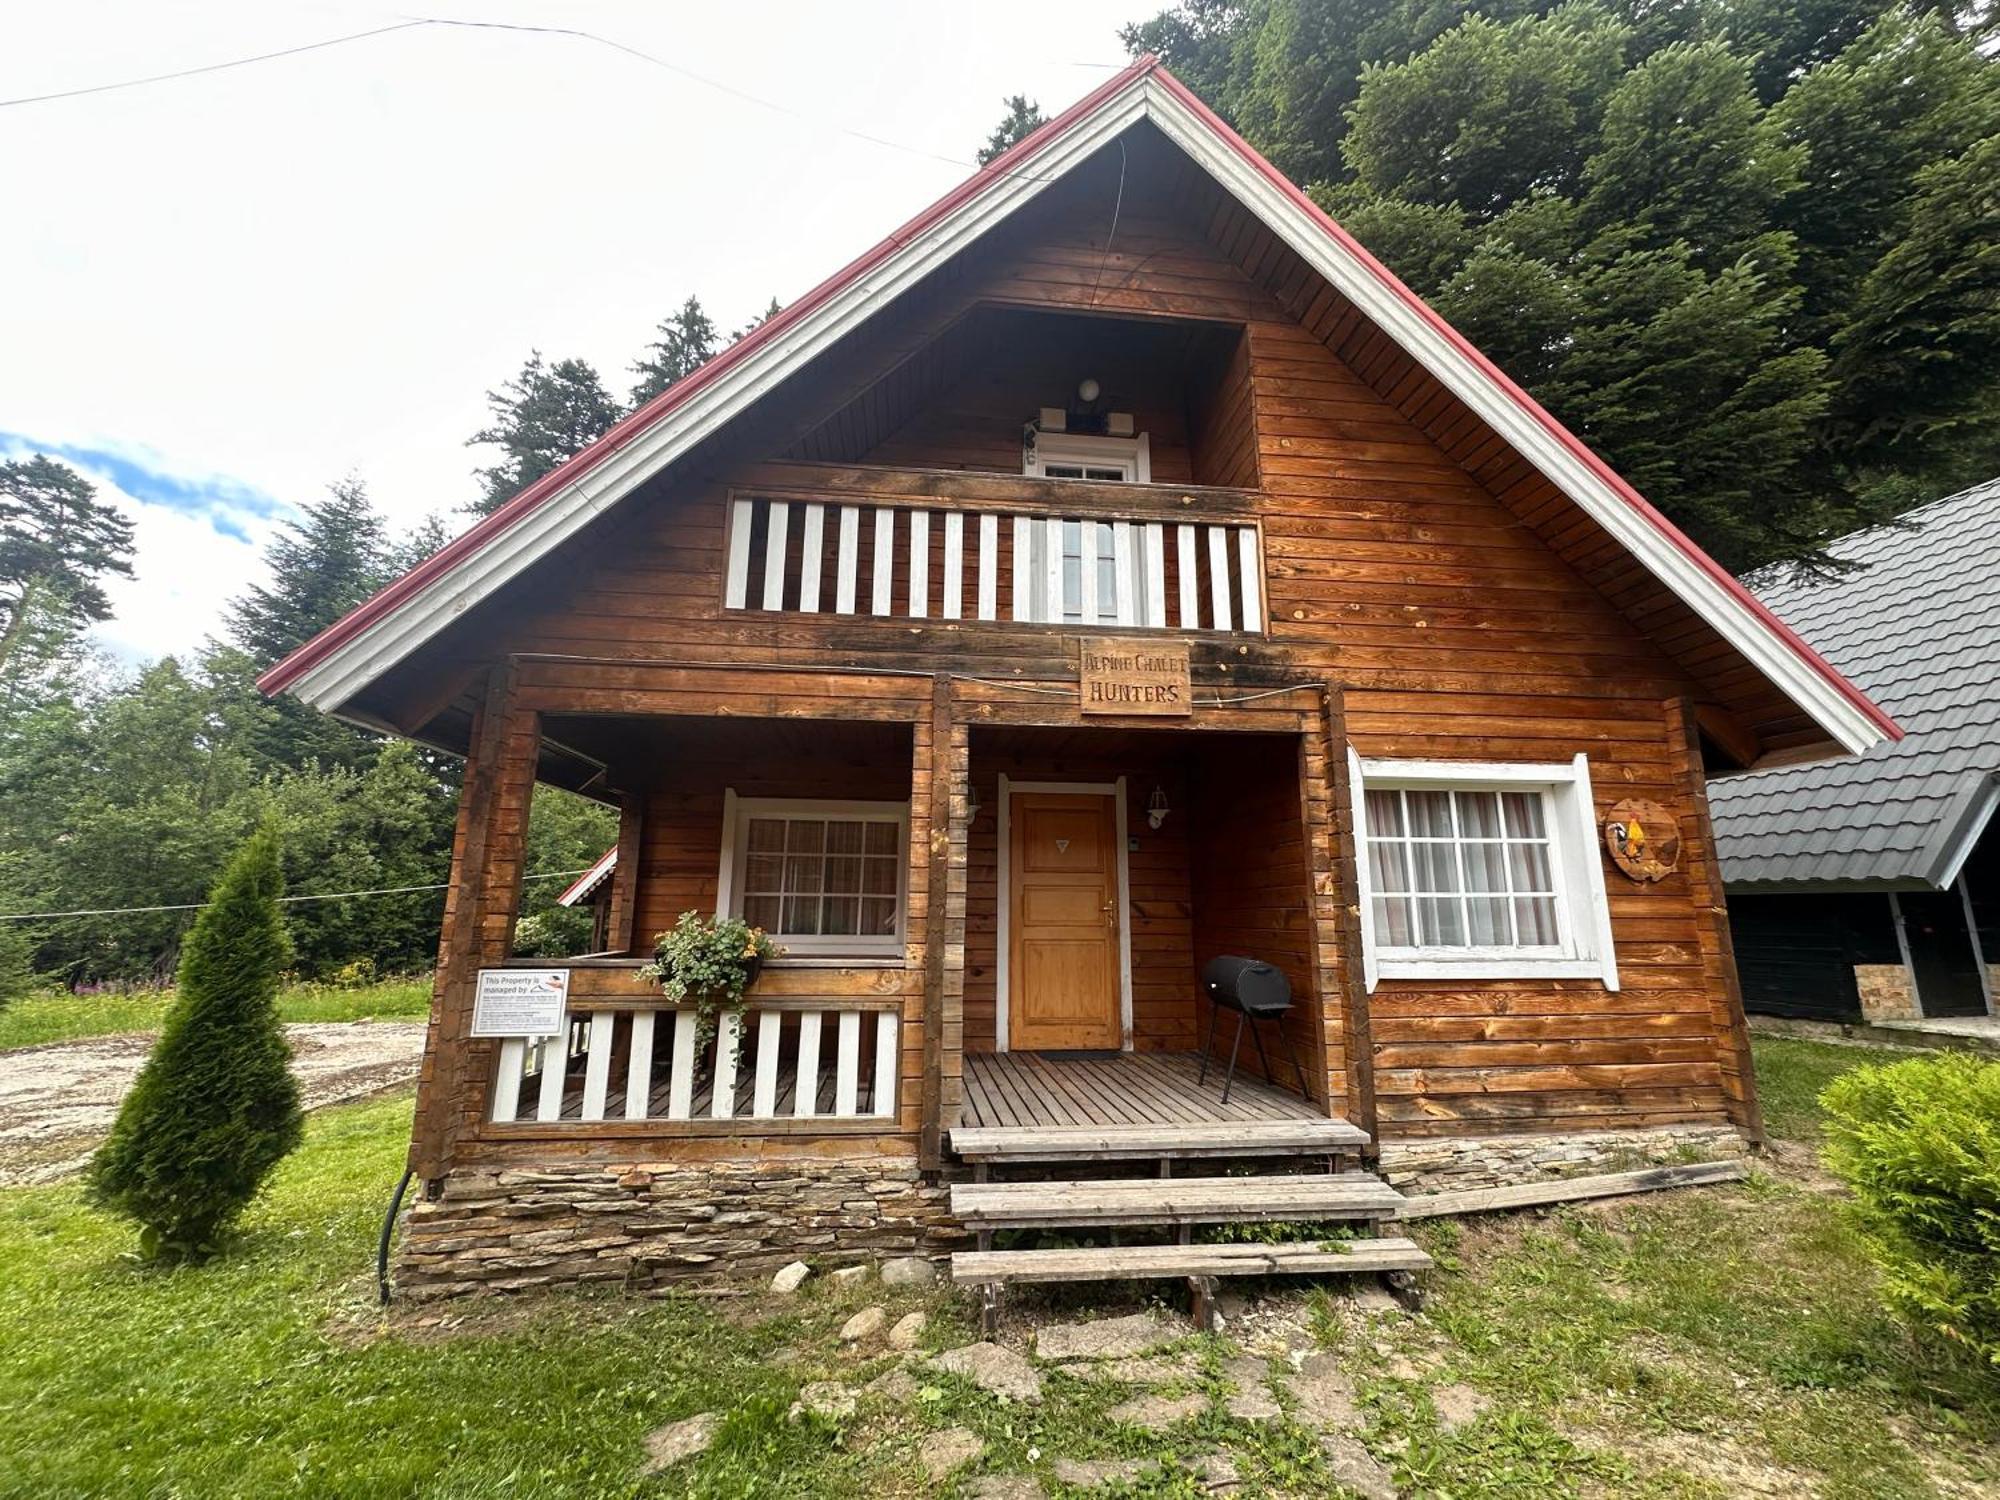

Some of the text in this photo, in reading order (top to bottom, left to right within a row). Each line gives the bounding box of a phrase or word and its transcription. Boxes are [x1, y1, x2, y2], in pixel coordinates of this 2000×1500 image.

[1135, 654, 1188, 673] CHALET
[1090, 682, 1179, 704] HUNTERS
[501, 977, 532, 985] Property
[483, 985, 528, 994] managed by
